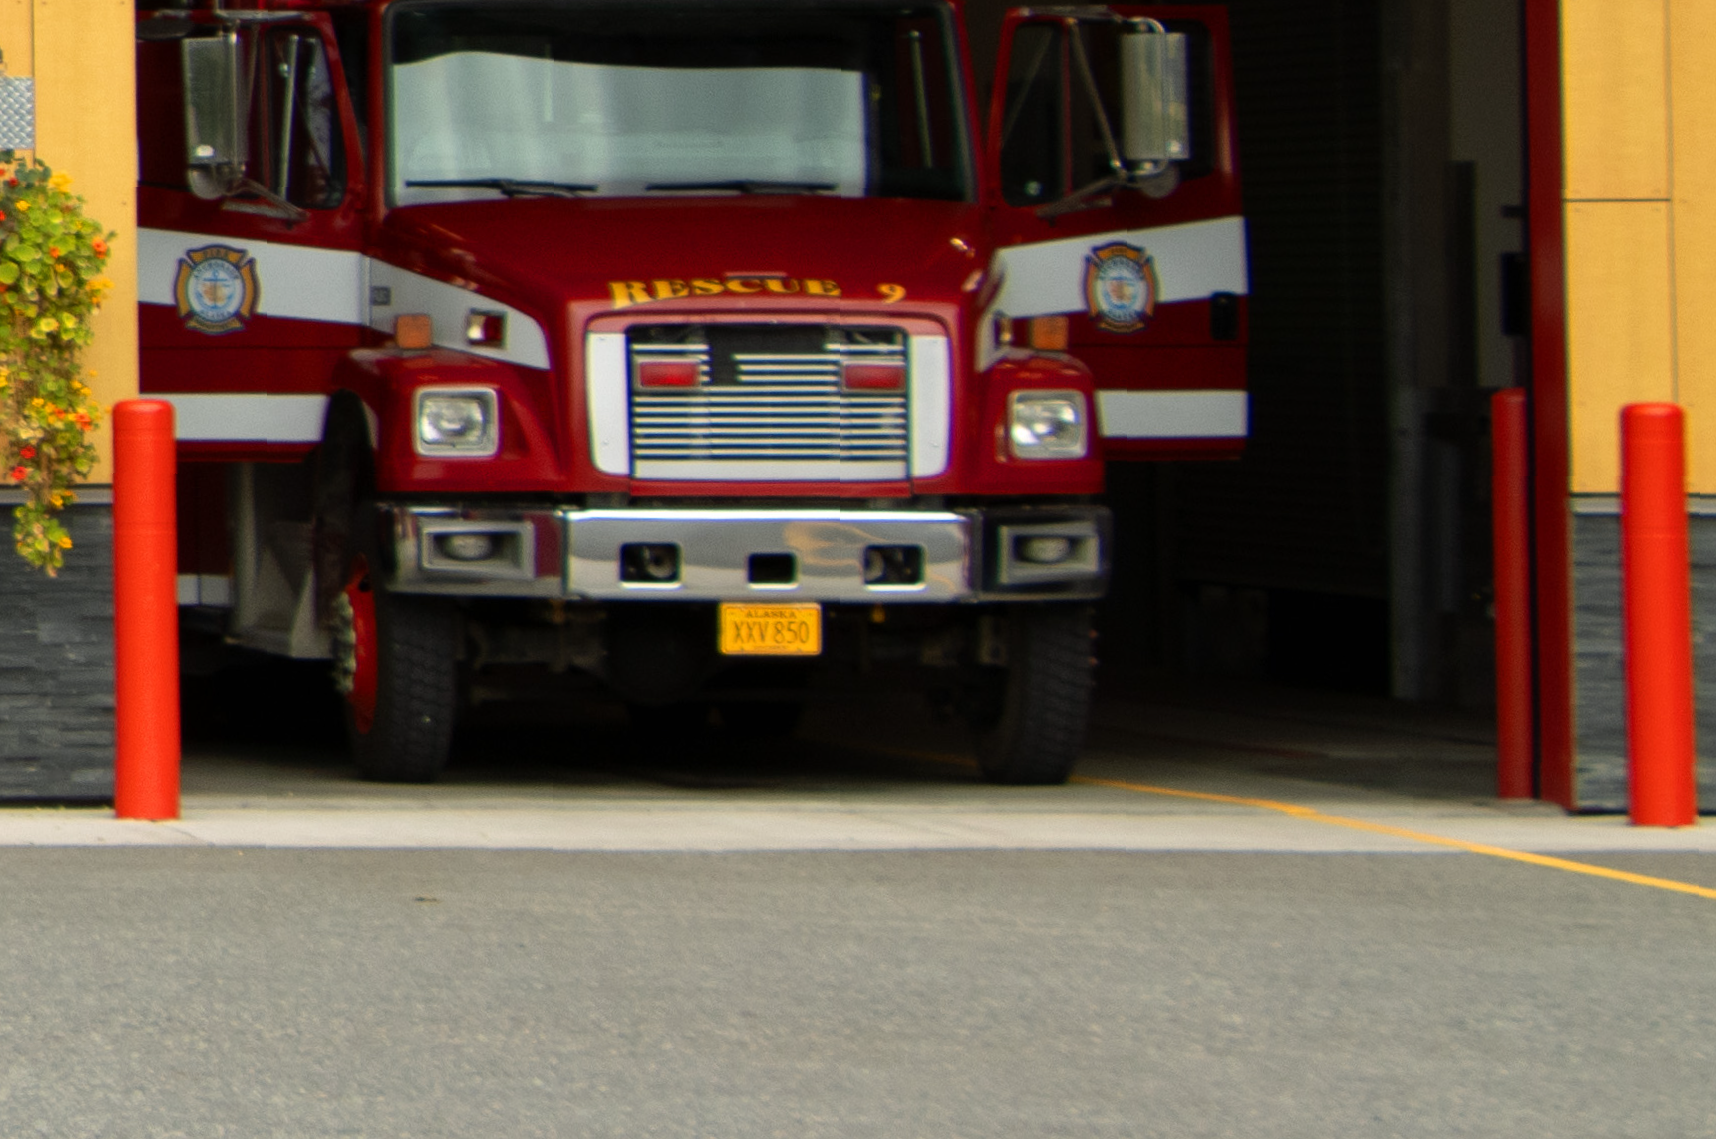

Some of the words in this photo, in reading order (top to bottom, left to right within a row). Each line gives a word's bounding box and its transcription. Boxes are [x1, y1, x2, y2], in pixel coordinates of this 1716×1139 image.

[609, 279, 841, 310] RESCUE
[878, 283, 906, 304] 9
[746, 610, 797, 619] ALASKA
[734, 621, 770, 643] XXV
[774, 621, 810, 644] 850
